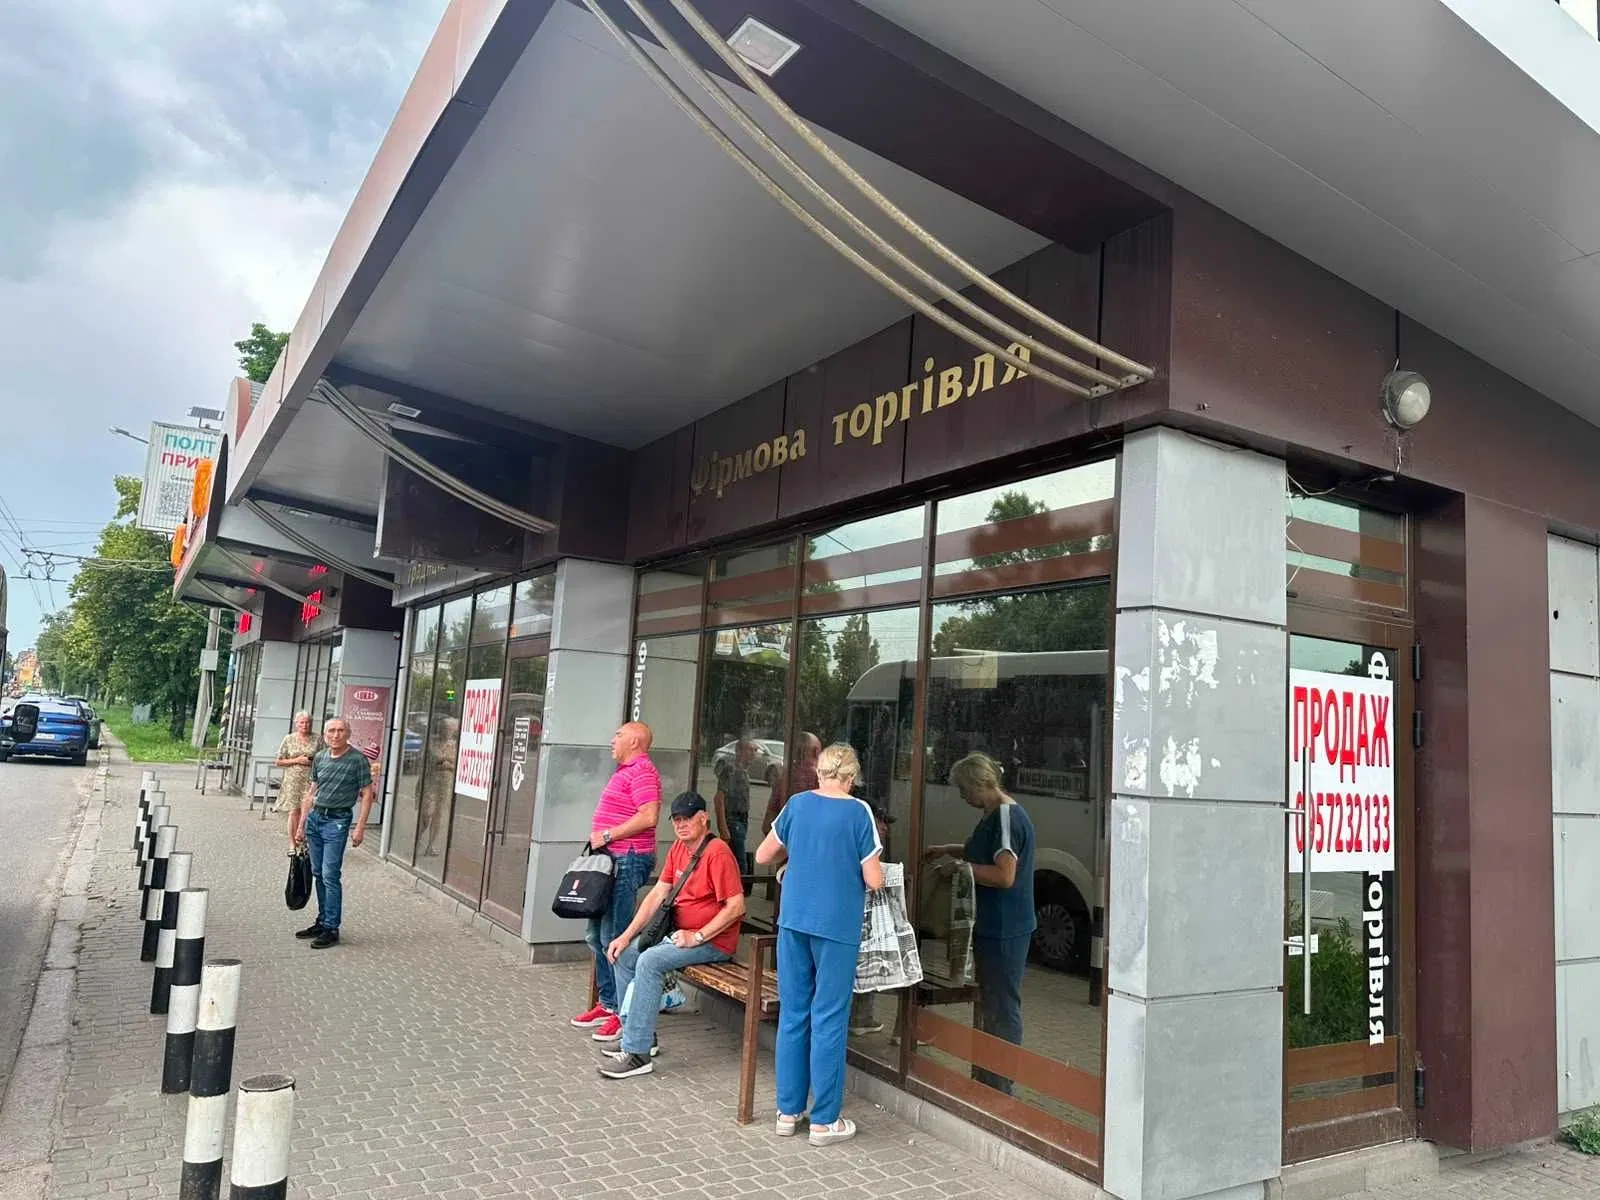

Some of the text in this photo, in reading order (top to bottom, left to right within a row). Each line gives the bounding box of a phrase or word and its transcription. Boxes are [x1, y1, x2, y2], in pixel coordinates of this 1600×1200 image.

[165, 434, 216, 453] ПОЛТ
[693, 341, 1032, 500] Фірмова торгівля
[633, 641, 648, 722] Фірмо
[1293, 687, 1390, 783] ПРОДАЖ
